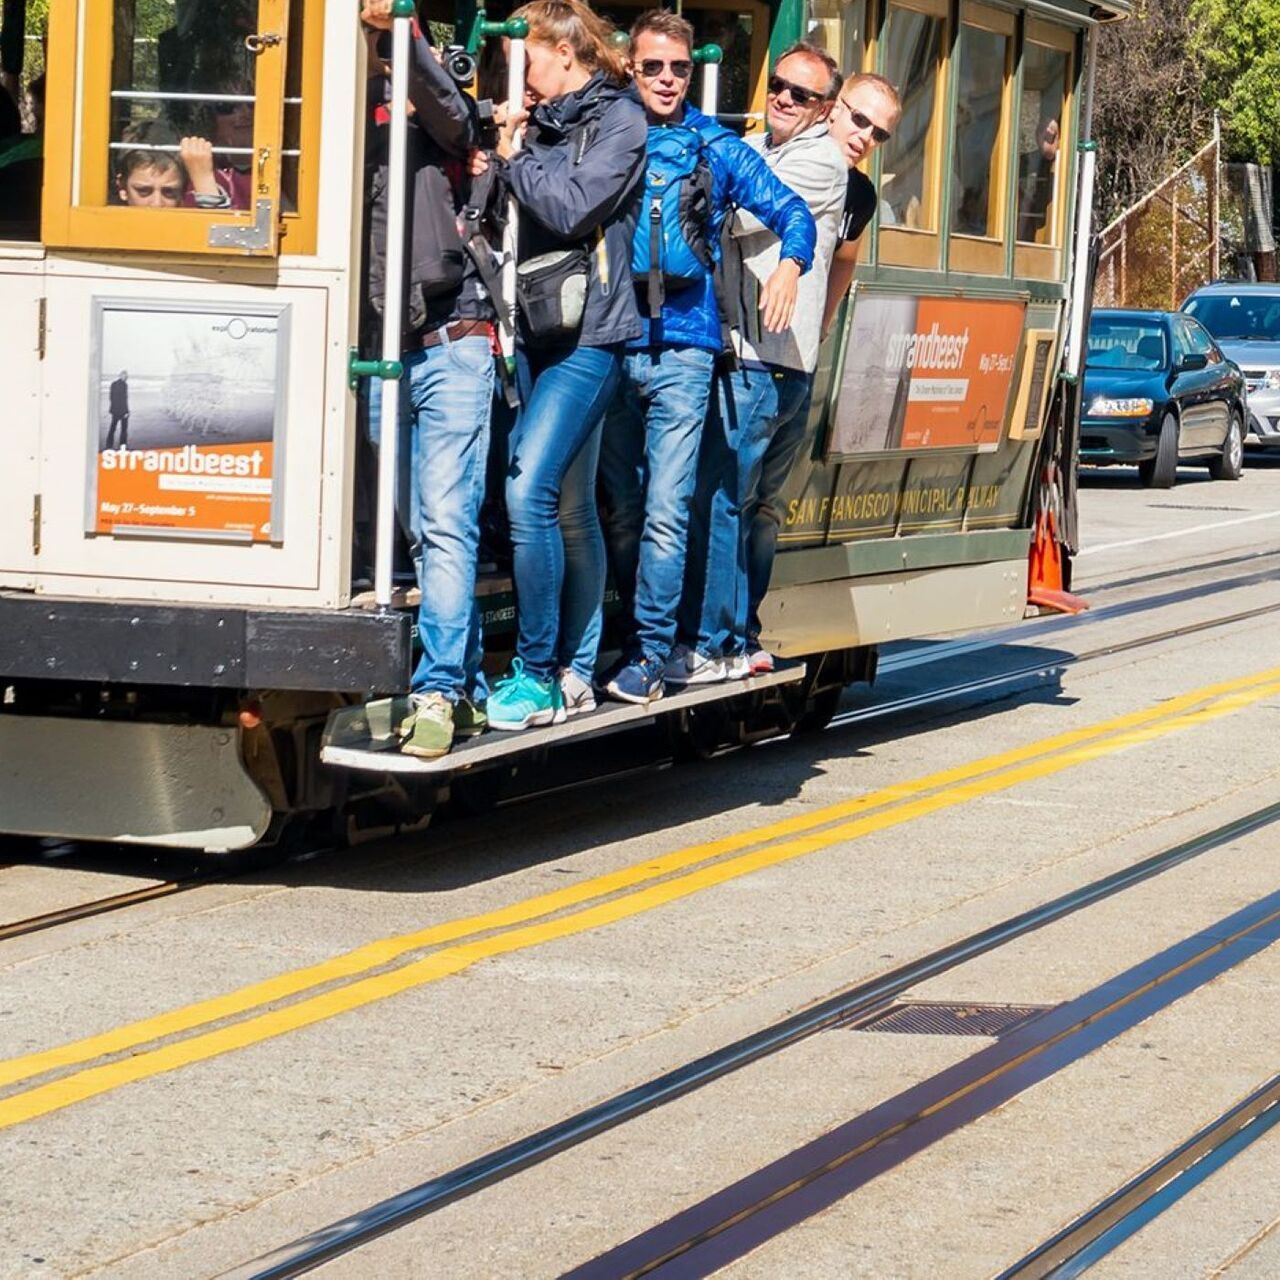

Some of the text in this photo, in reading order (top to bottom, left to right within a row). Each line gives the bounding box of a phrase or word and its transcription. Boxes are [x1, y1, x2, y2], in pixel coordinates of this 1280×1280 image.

[886, 322, 970, 369] strandbeest
[101, 444, 264, 476] strandbeest
[101, 502, 120, 515] May
[188, 506, 196, 516] 5
[786, 498, 817, 525] SAN
